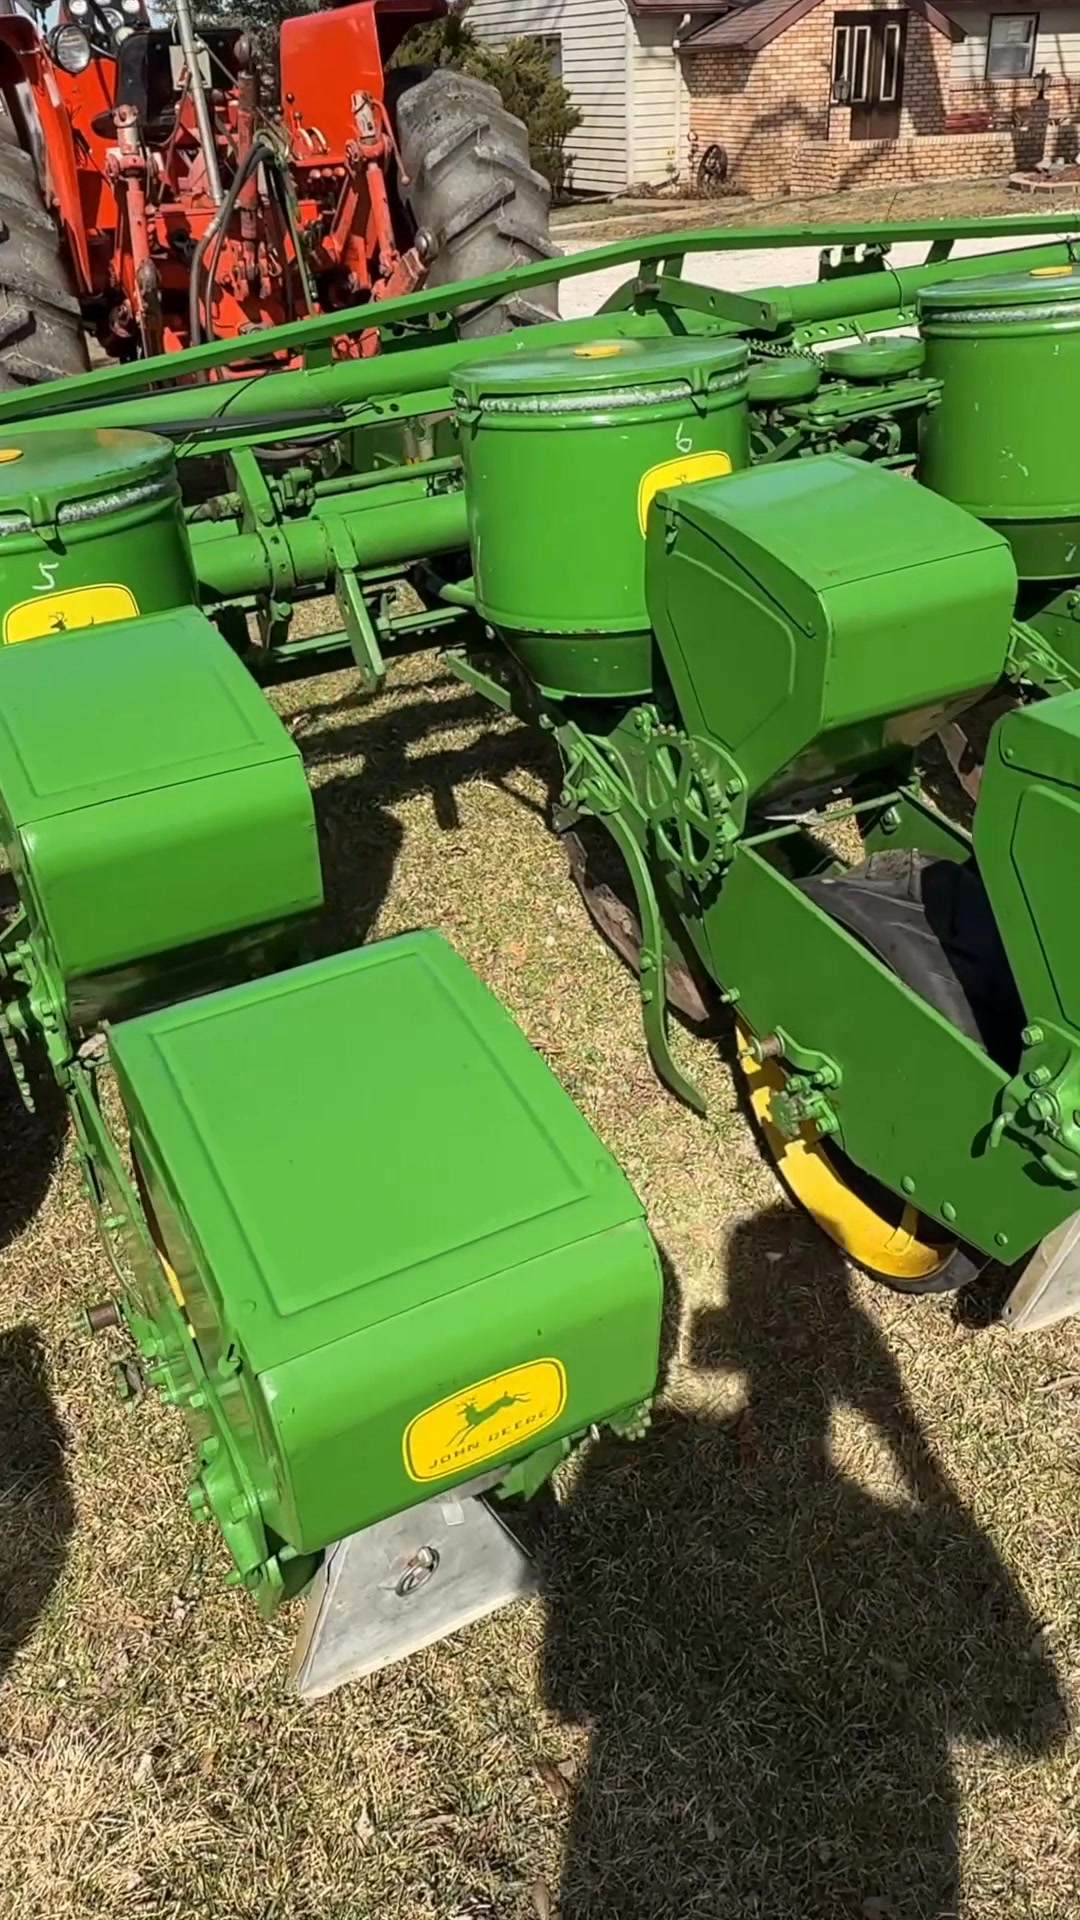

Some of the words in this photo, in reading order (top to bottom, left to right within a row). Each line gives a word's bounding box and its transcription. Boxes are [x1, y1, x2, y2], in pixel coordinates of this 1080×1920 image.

[676, 422, 692, 453] 6
[32, 562, 59, 591] 5
[429, 1442, 480, 1469] JOHN
[488, 1409, 547, 1442] DEERE
